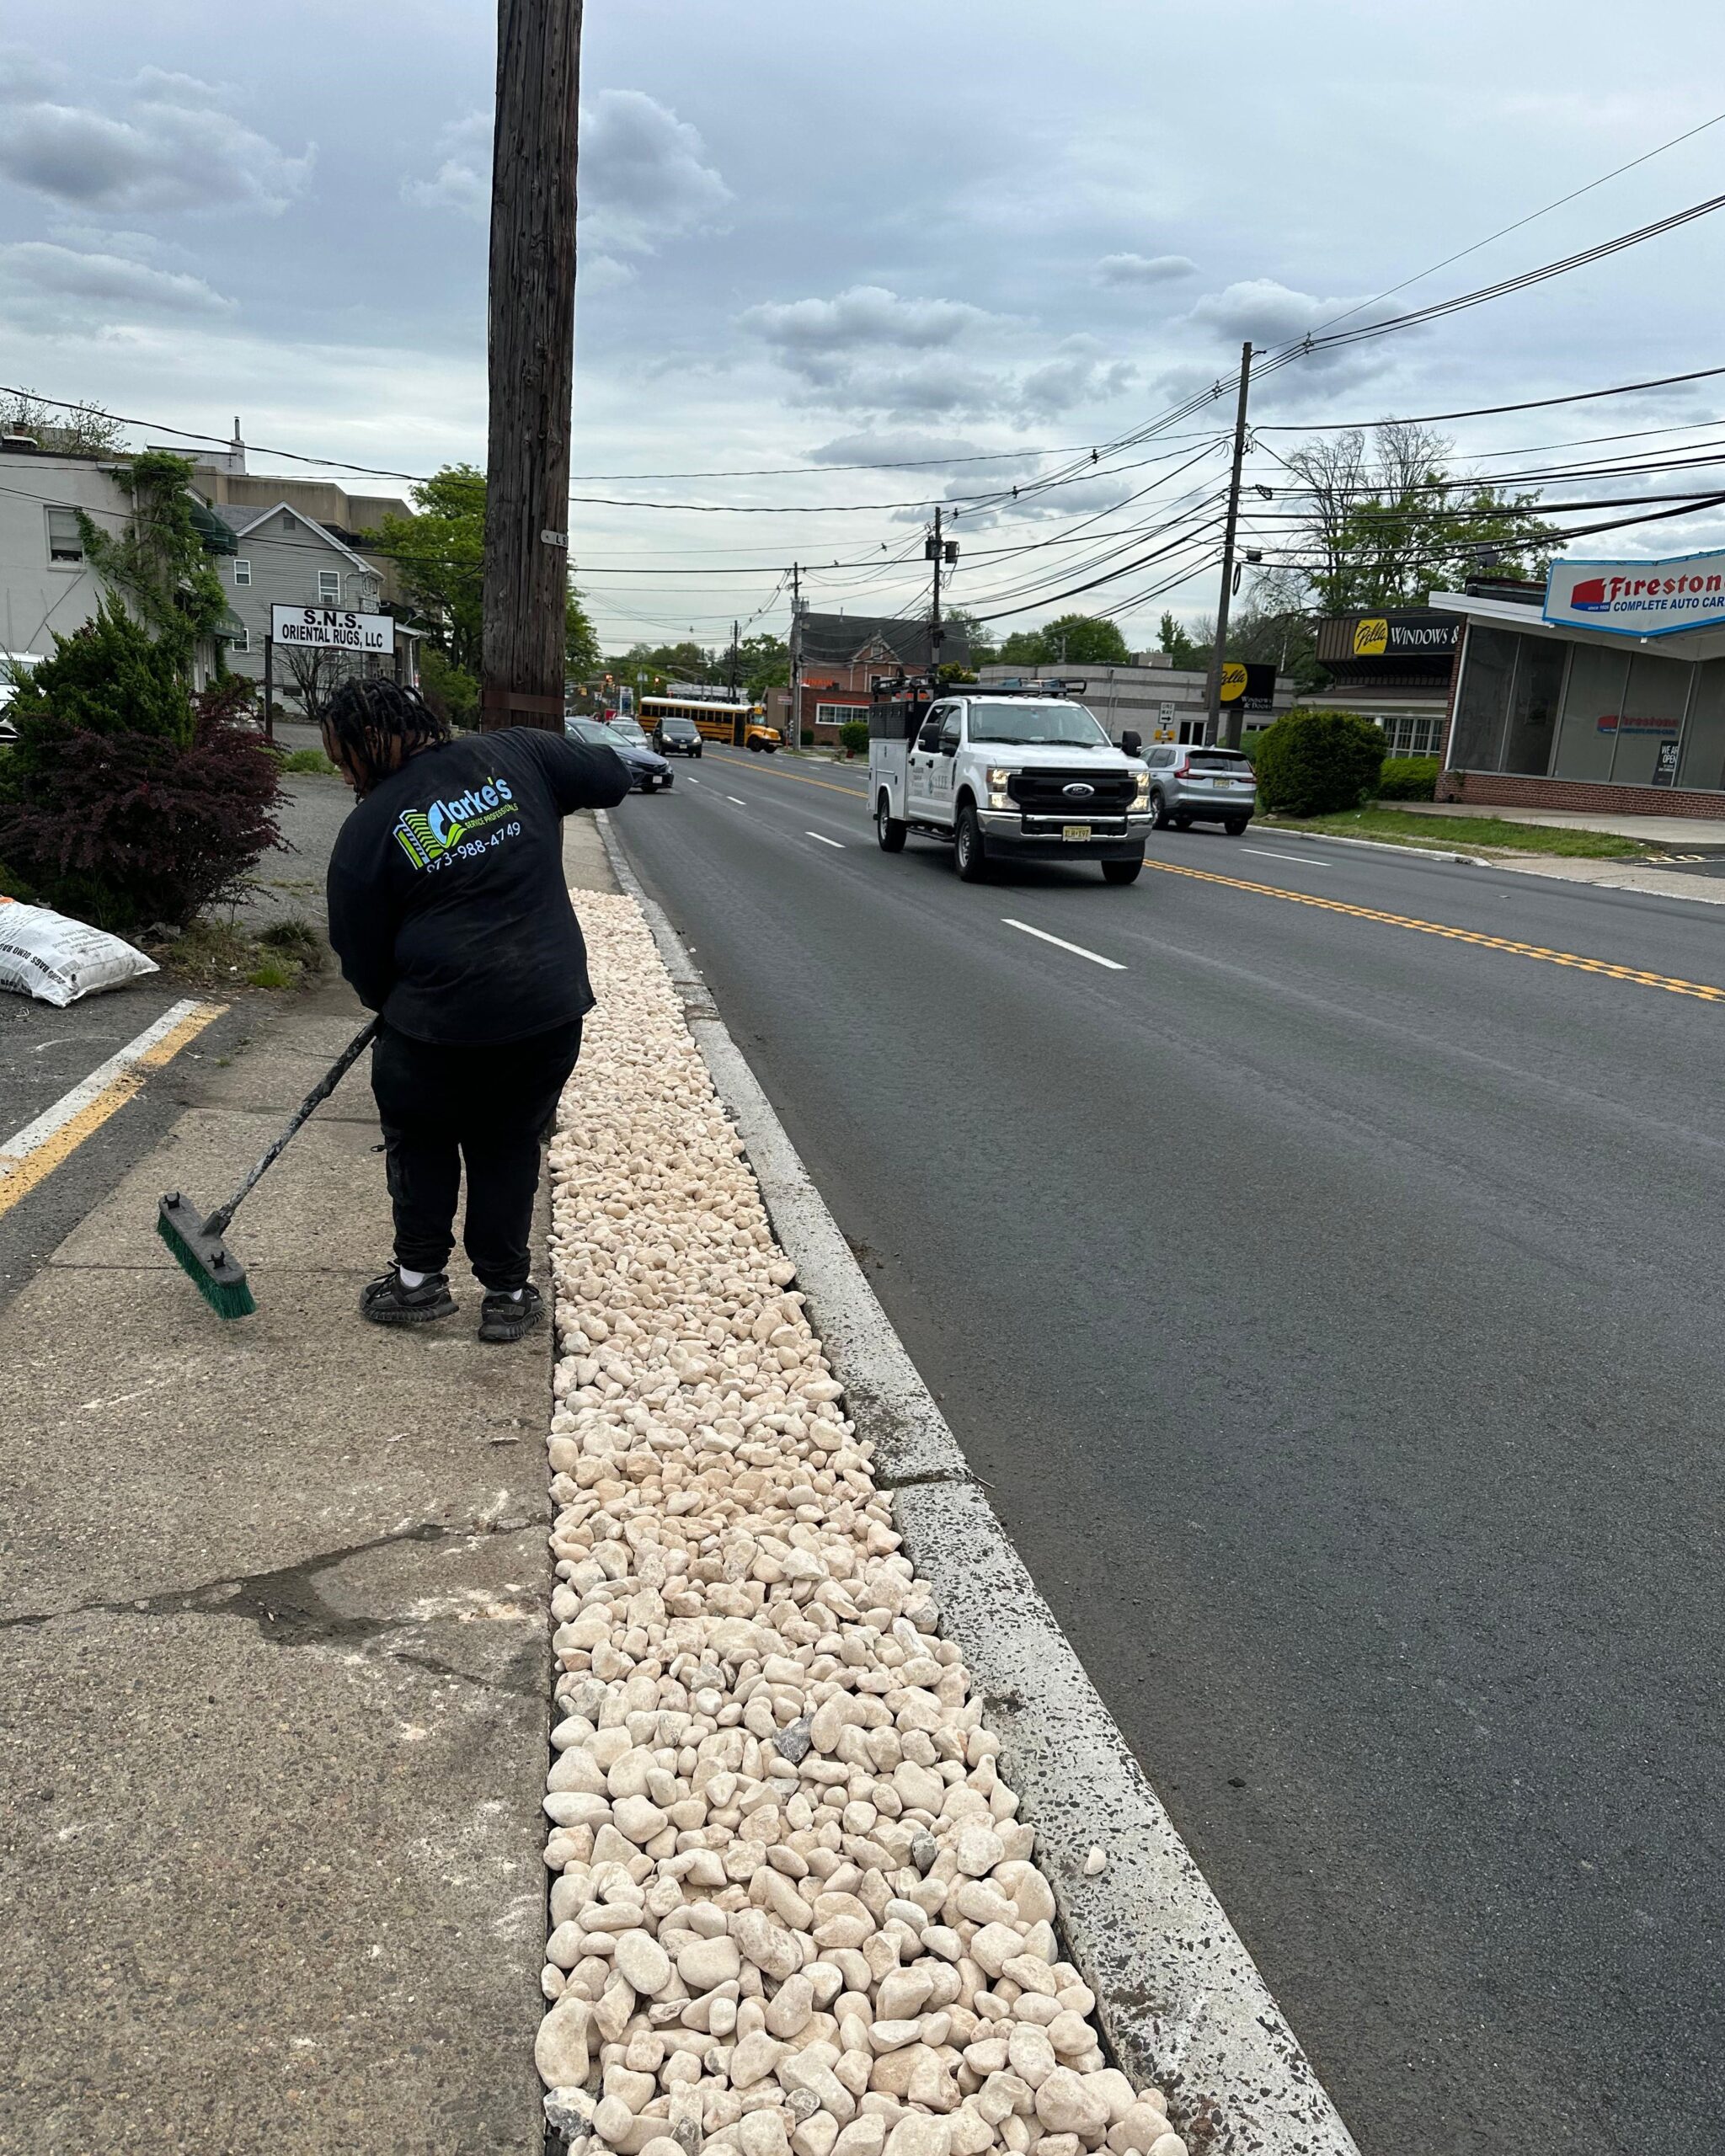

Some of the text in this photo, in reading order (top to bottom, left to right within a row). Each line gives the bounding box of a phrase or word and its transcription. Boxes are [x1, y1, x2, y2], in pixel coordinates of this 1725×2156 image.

[1609, 574, 1725, 602] Fireston
[1614, 595, 1725, 611] COMPLETE AUTO CAR
[303, 609, 362, 629] S.N.S.
[282, 624, 383, 648] ORIENTAL RUGS, LLC
[1357, 622, 1387, 651] Pella
[1450, 625, 1460, 644] &
[1662, 745, 1671, 755] WE
[427, 776, 513, 848] Clarke's
[13, 947, 31, 959] DEMO
[30, 956, 50, 974] BAGS
